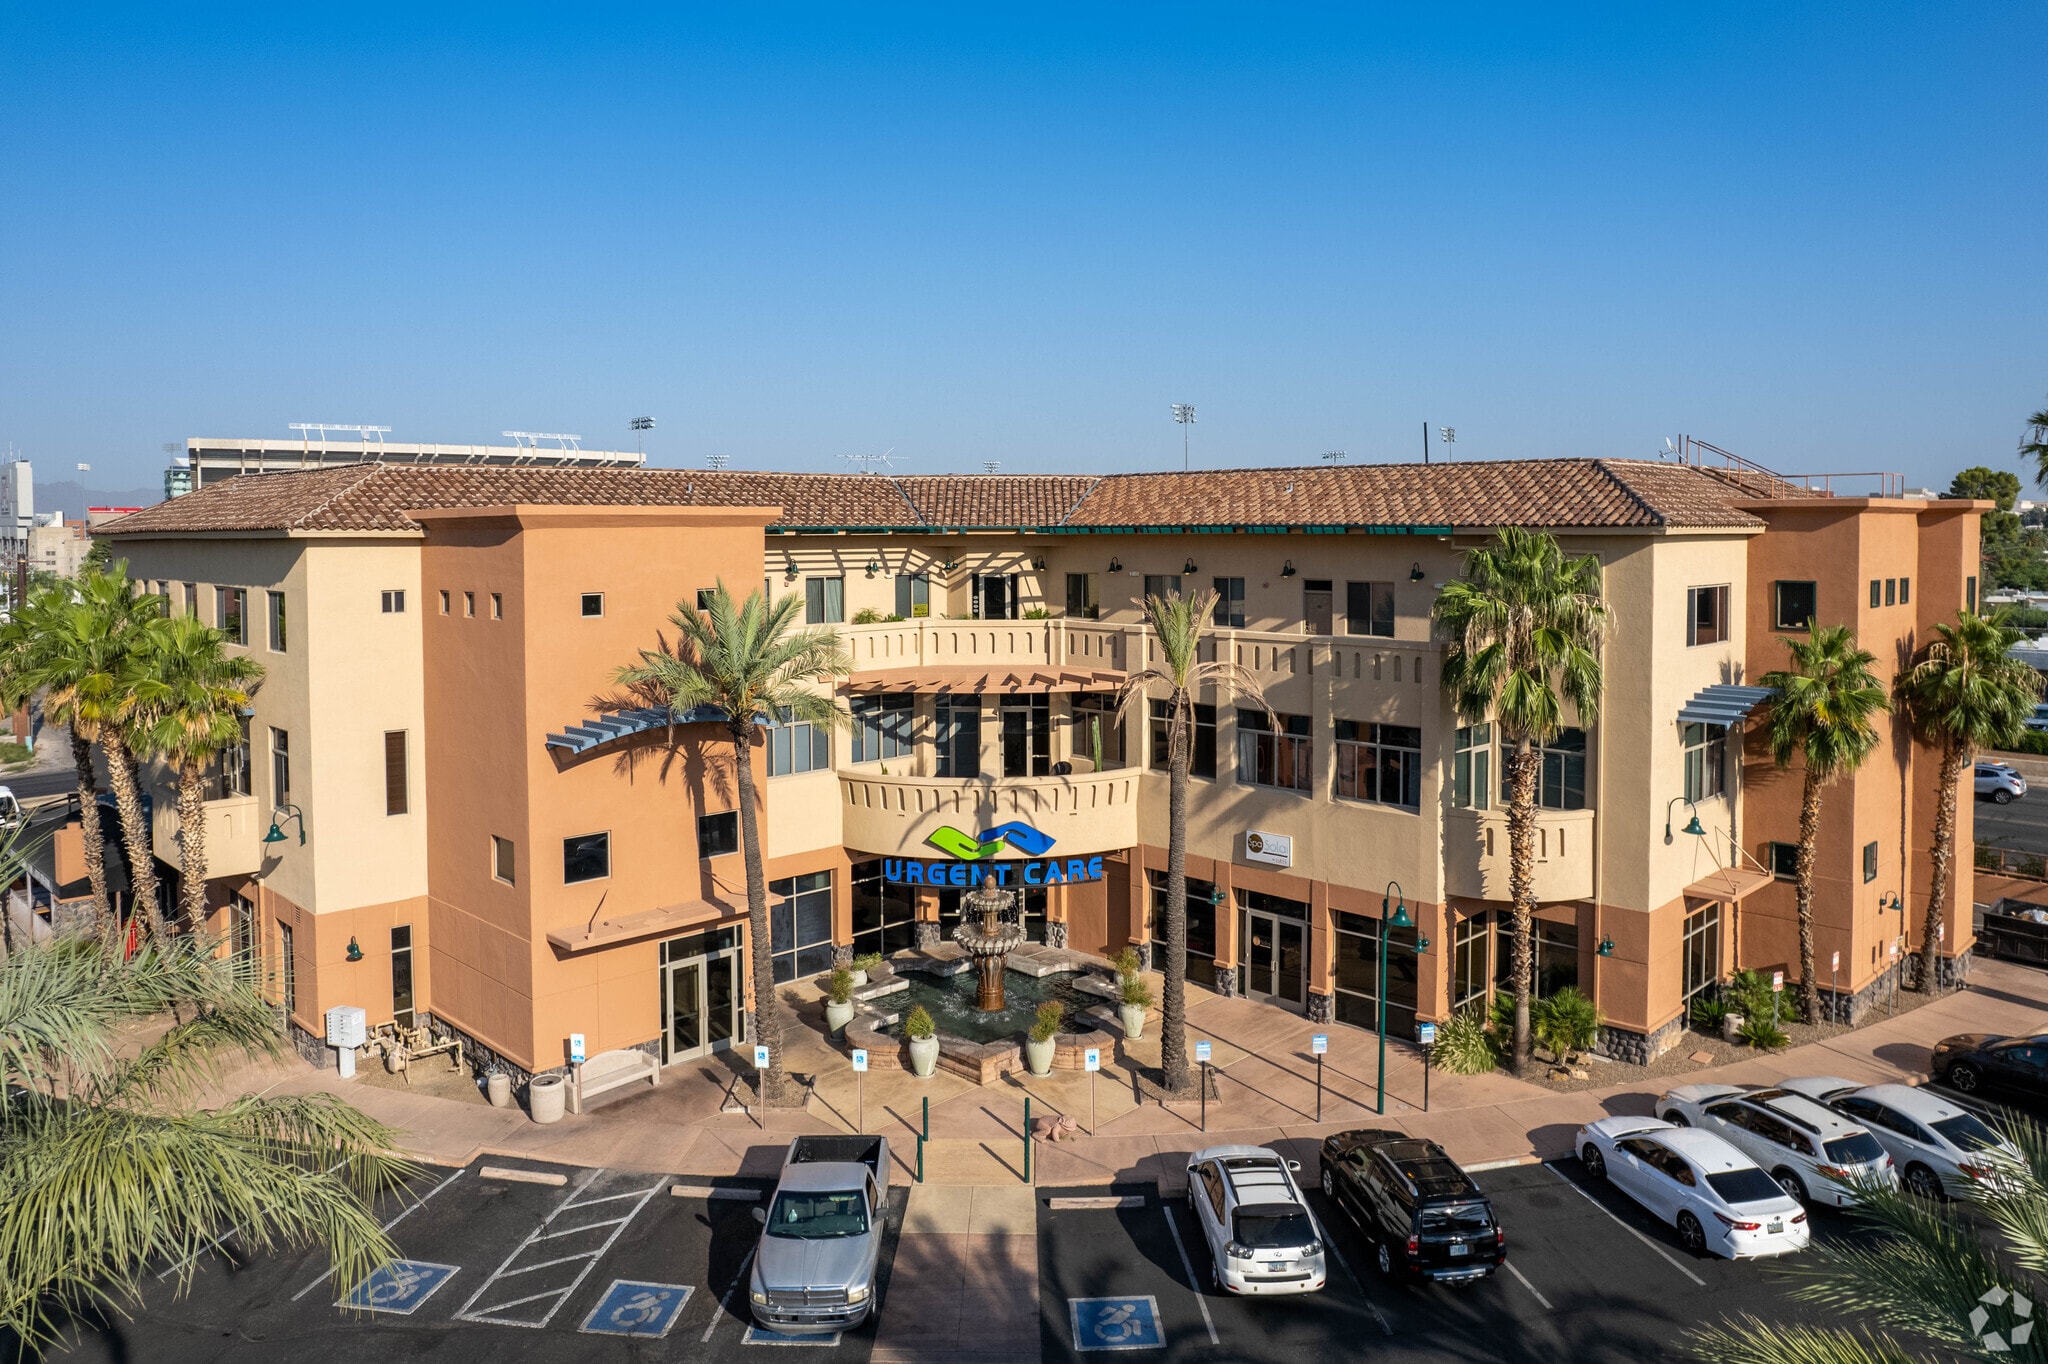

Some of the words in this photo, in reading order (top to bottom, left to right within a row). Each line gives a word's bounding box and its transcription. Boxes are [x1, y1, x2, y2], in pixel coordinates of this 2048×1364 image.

[1248, 838, 1262, 849] Spa
[885, 859, 1012, 886] URGENT
[1024, 856, 1103, 884] CARE
